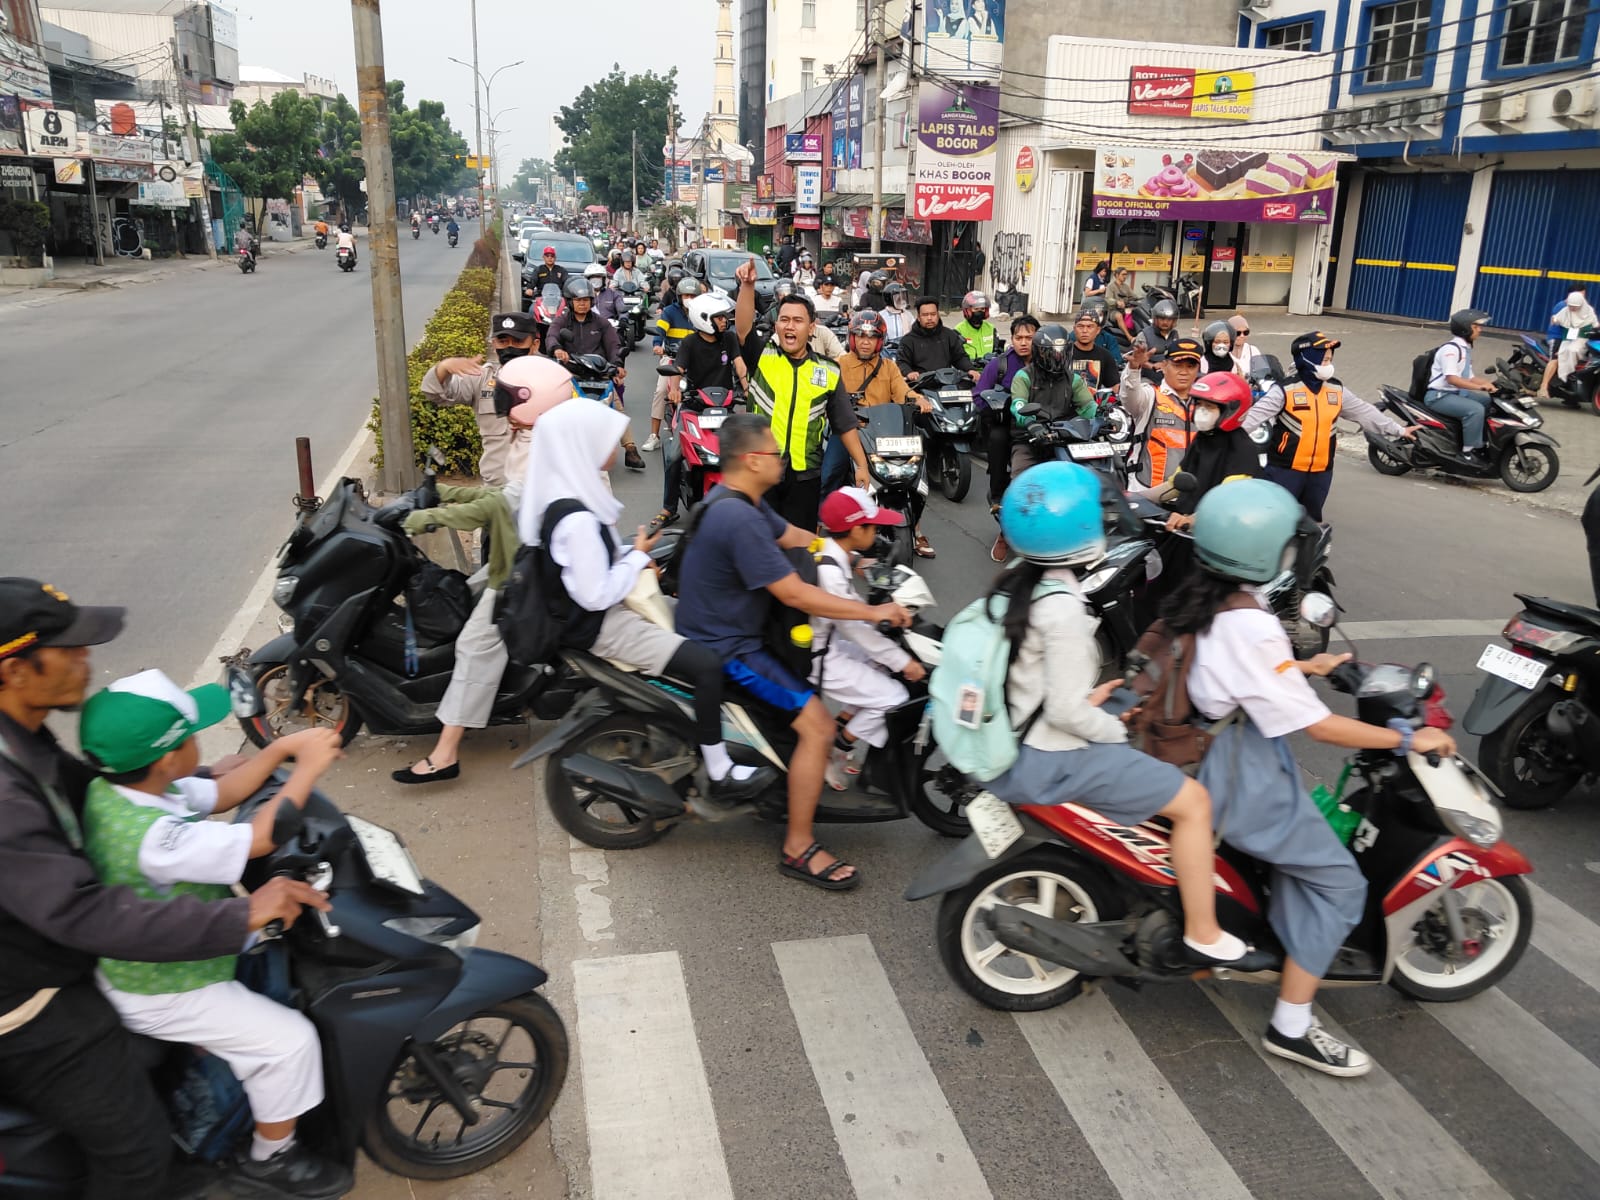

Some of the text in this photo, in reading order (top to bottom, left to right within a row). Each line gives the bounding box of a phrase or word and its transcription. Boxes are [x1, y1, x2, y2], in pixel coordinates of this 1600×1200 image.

[1136, 72, 1158, 80] ROTI
[1133, 81, 1192, 100] Venus
[1163, 100, 1189, 110] Bakery
[1192, 103, 1209, 113] LAPIS
[1210, 104, 1228, 114] TALAS
[921, 122, 995, 137] LAPIS TALAS
[936, 137, 978, 150] BOGOR
[937, 161, 975, 169] OLEH-OLEH
[919, 169, 991, 181] KHAS BOGOR
[918, 185, 980, 195] ROTI UNYIL
[916, 192, 991, 217] Venus
[1124, 201, 1154, 209] OFFICIAL
